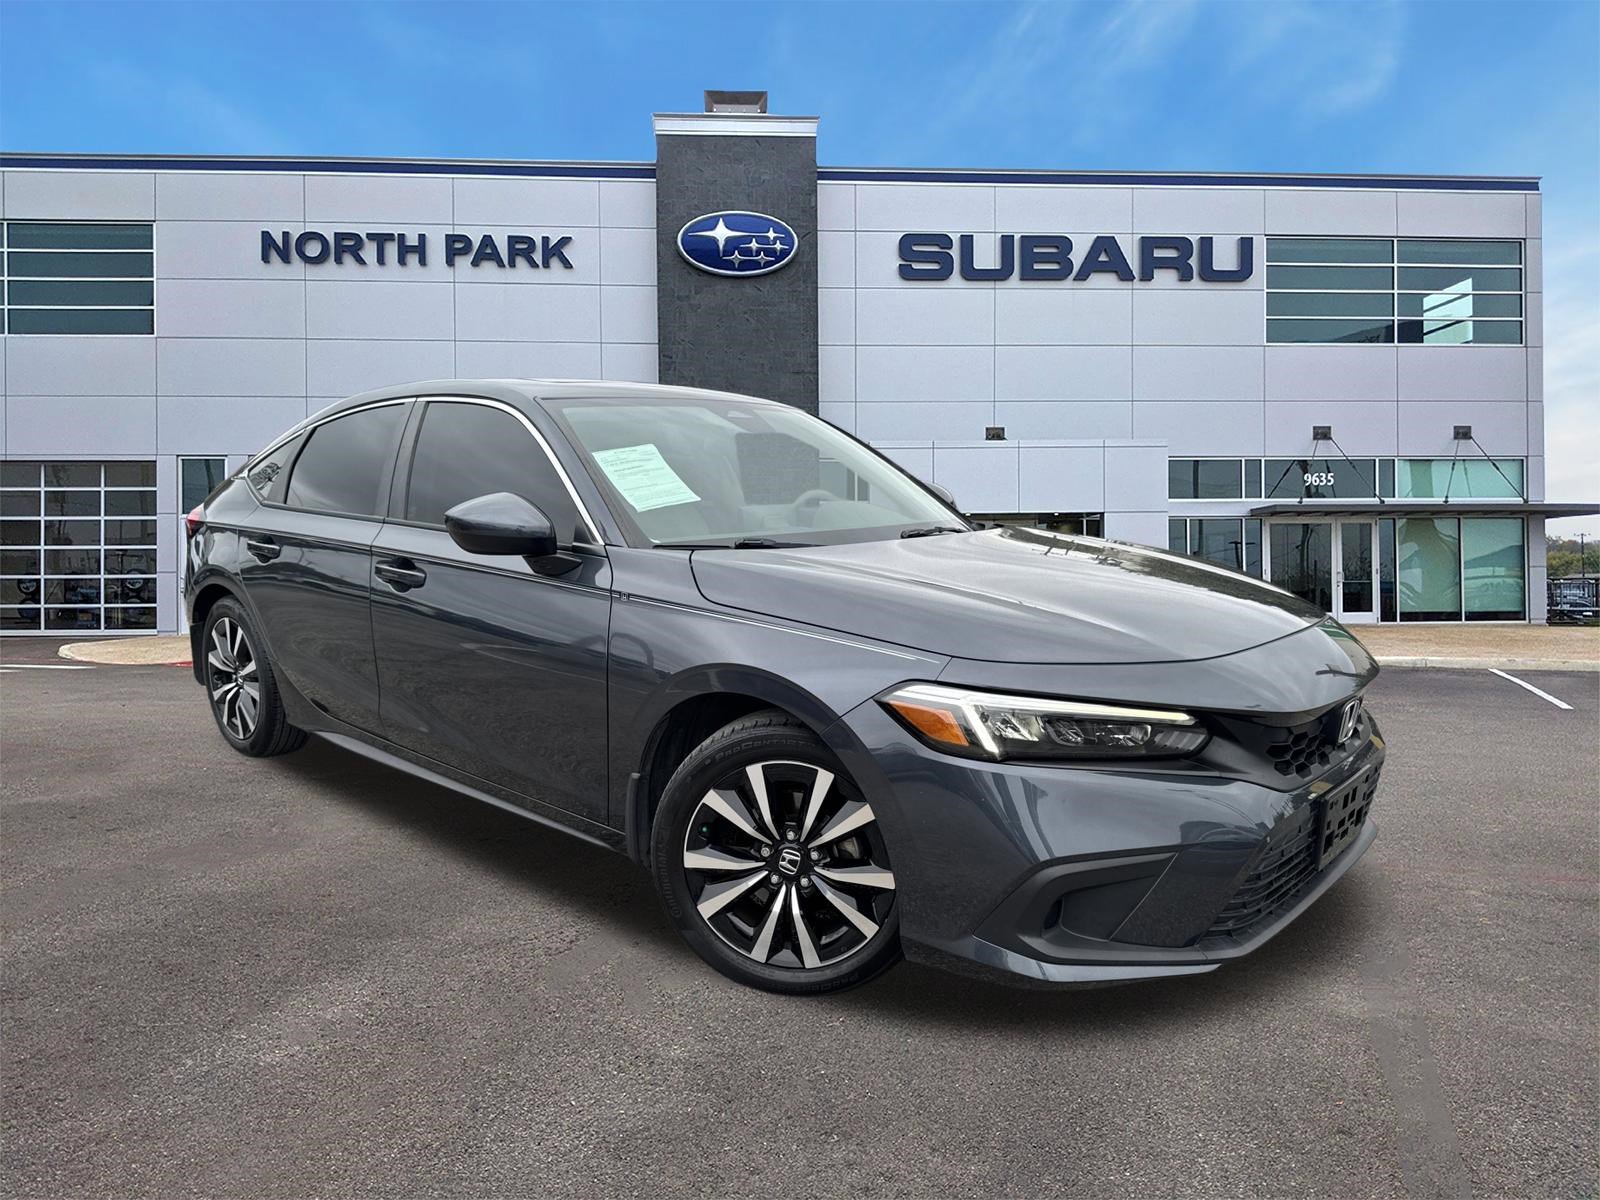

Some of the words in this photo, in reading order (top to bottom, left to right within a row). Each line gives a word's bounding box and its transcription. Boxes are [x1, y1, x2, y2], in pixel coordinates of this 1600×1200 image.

[260, 230, 427, 266] NORTH
[445, 233, 574, 269] PARK
[898, 233, 1254, 282] SUBARU
[1303, 472, 1335, 486] 9635
